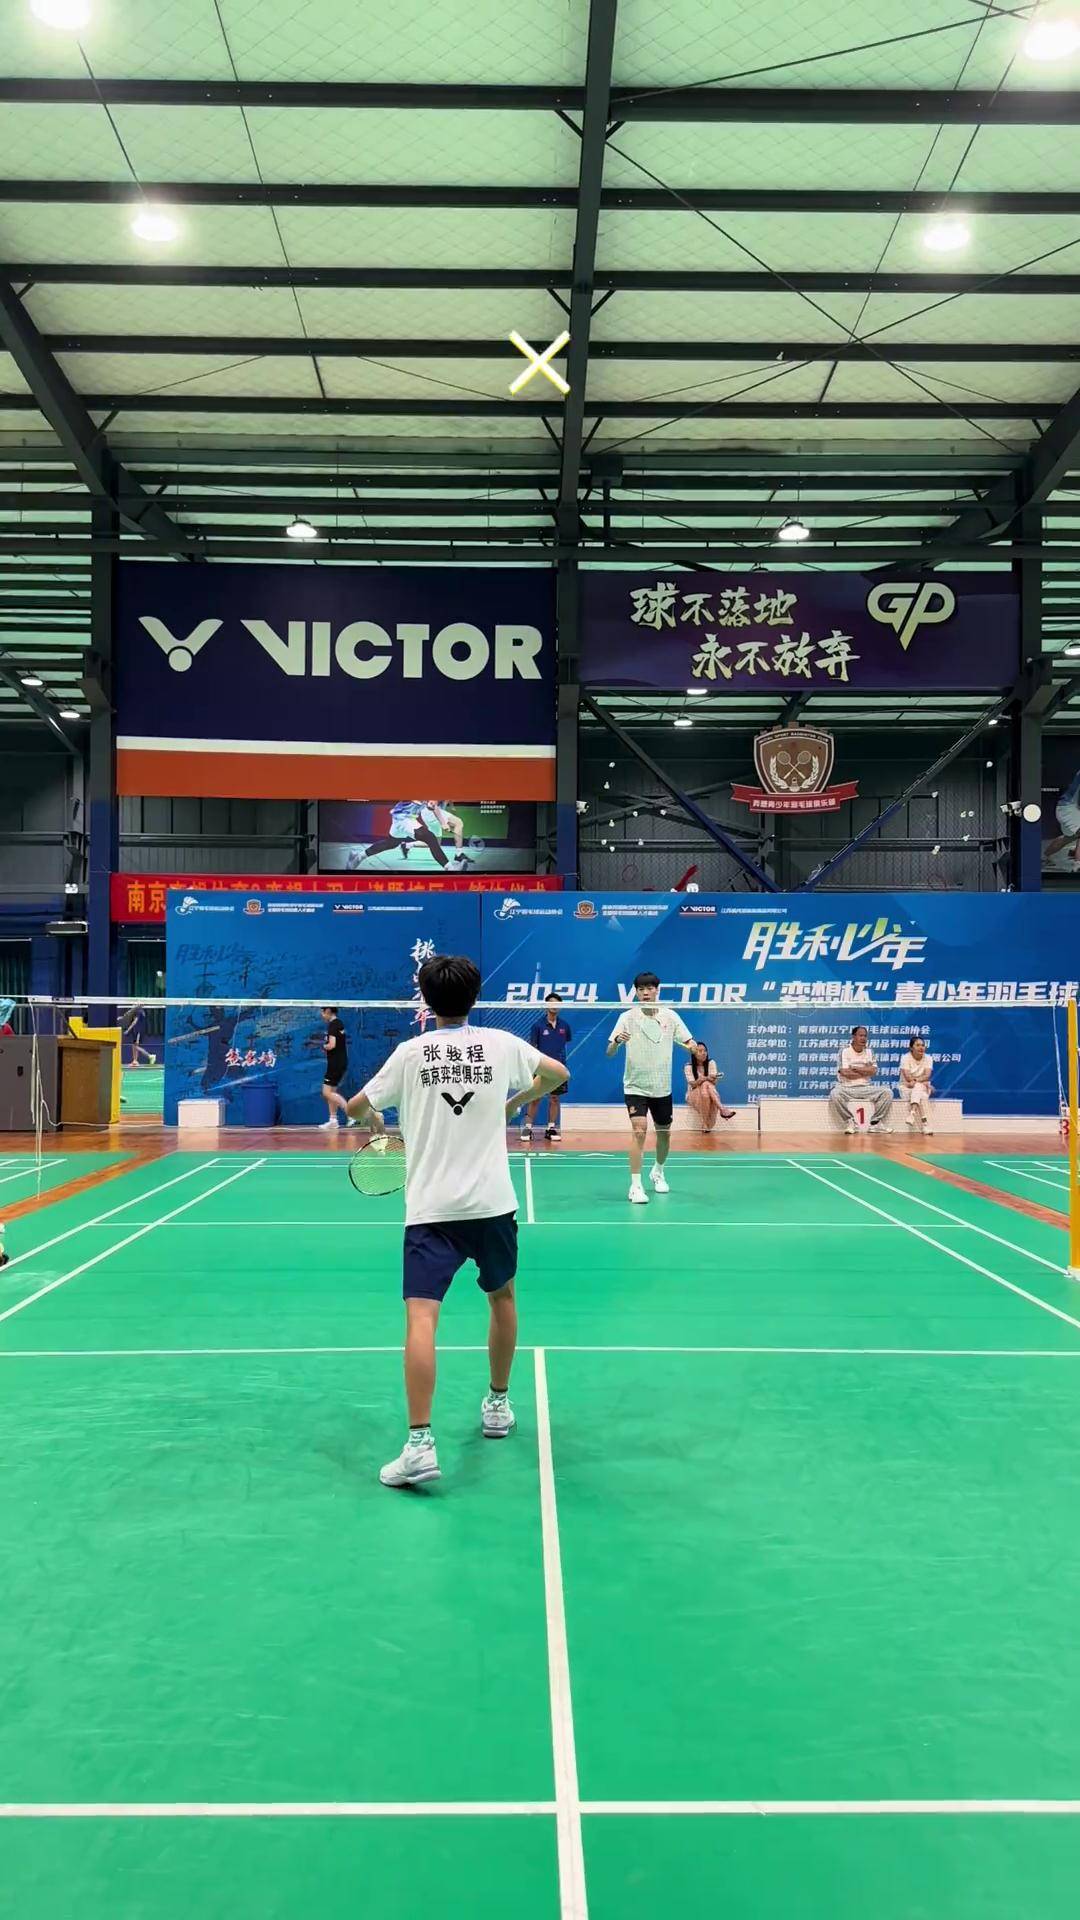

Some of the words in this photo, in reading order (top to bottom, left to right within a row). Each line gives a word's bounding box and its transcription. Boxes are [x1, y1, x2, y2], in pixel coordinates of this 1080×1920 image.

[630, 581, 798, 630] 球不落地
[241, 619, 543, 680] VICTOR
[691, 630, 860, 681] 永不放弃
[742, 917, 928, 971] 胜利少年
[506, 982, 599, 1004] 2024
[617, 982, 747, 1005] VCTOR
[423, 1044, 486, 1064] 张骏程
[856, 1107, 865, 1125] 1
